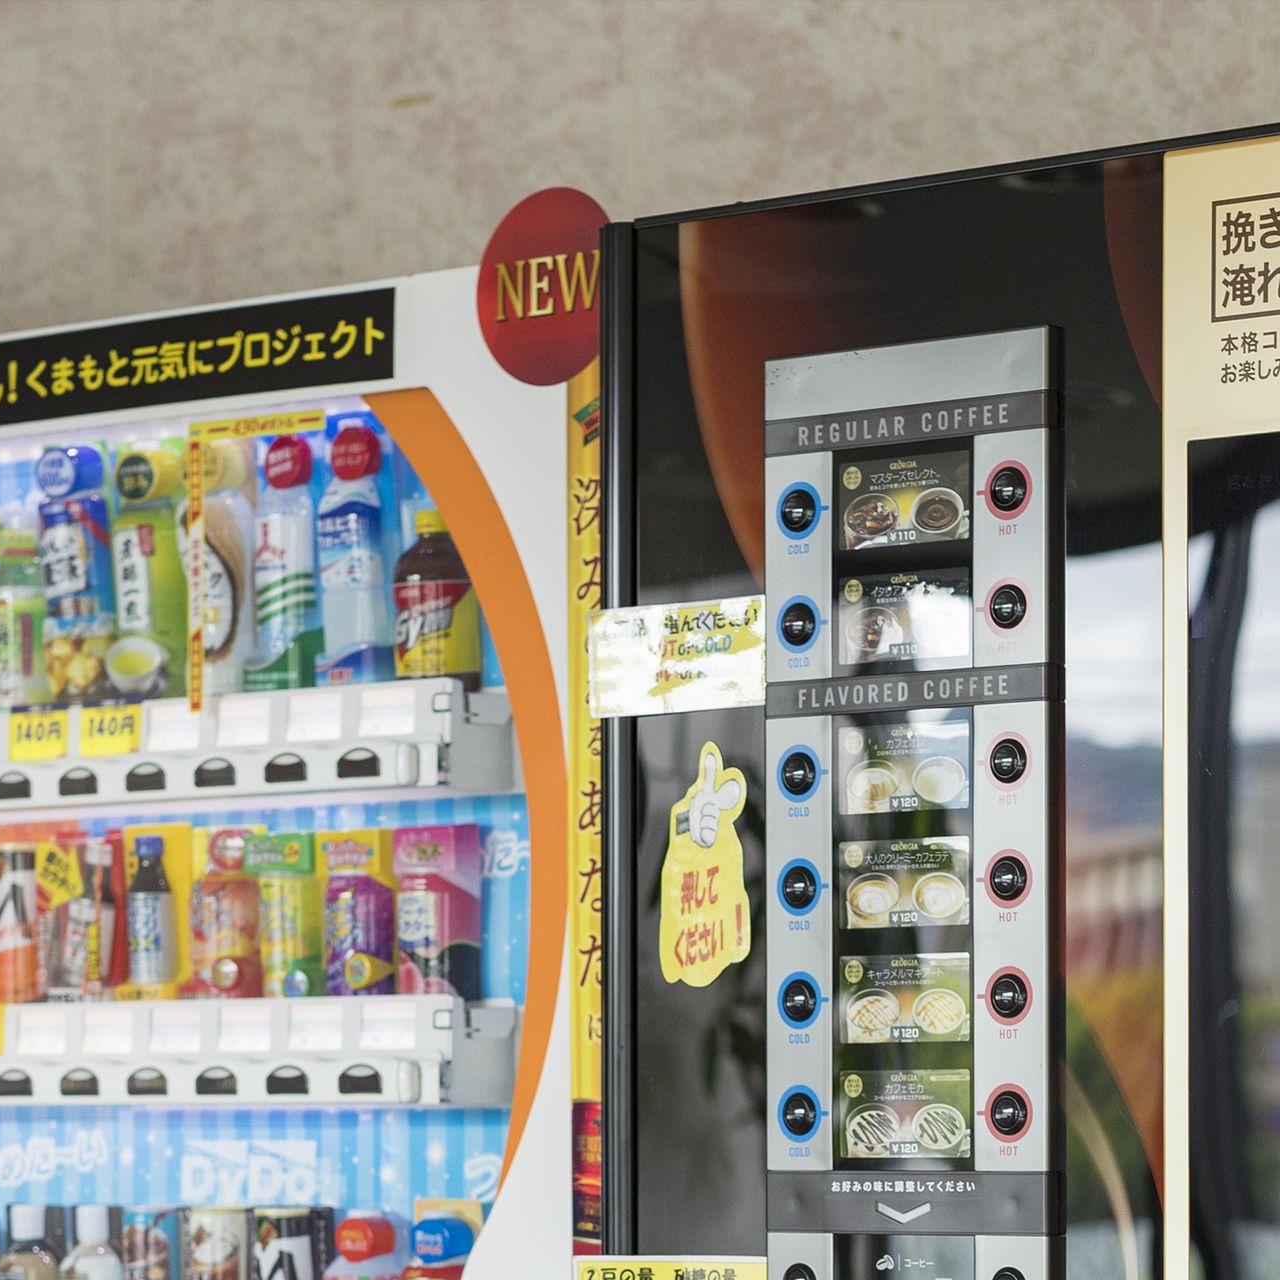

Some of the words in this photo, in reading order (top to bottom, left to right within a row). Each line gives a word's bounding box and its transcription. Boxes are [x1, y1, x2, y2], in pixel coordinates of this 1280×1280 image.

[494, 249, 601, 323] NEW
[797, 415, 905, 447] REGULAR
[921, 403, 1009, 433] COFFEE
[889, 529, 917, 541] ¥110
[998, 524, 1018, 536] HOT
[787, 544, 810, 555] COLD
[890, 644, 918, 656] ¥110
[787, 657, 810, 668] COLD
[797, 682, 909, 709] FLAVORED
[923, 674, 1009, 700] COFFEE
[17, 721, 61, 743] 140円
[90, 714, 136, 738] 140円
[891, 797, 918, 807] ¥120
[787, 806, 810, 818] COLD
[865, 852, 949, 865] 大人のクリーミーカフェラテ
[680, 866, 720, 917] 押して
[891, 912, 918, 923] ¥120
[999, 912, 1018, 923] HOT
[788, 920, 811, 931] COLD
[673, 902, 743, 968] ください!
[788, 1033, 811, 1044] COLD
[892, 1027, 919, 1039] ¥120
[999, 1029, 1018, 1040] HOT
[884, 1083, 924, 1095] カフェモカ
[788, 1146, 811, 1158] COLD
[891, 1143, 918, 1154] ¥120
[999, 1146, 1019, 1157] HOT
[181, 1138, 318, 1201] DyDo
[831, 1180, 976, 1193] お好みの味に調整してください
[904, 1257, 934, 1268] コーヒー
